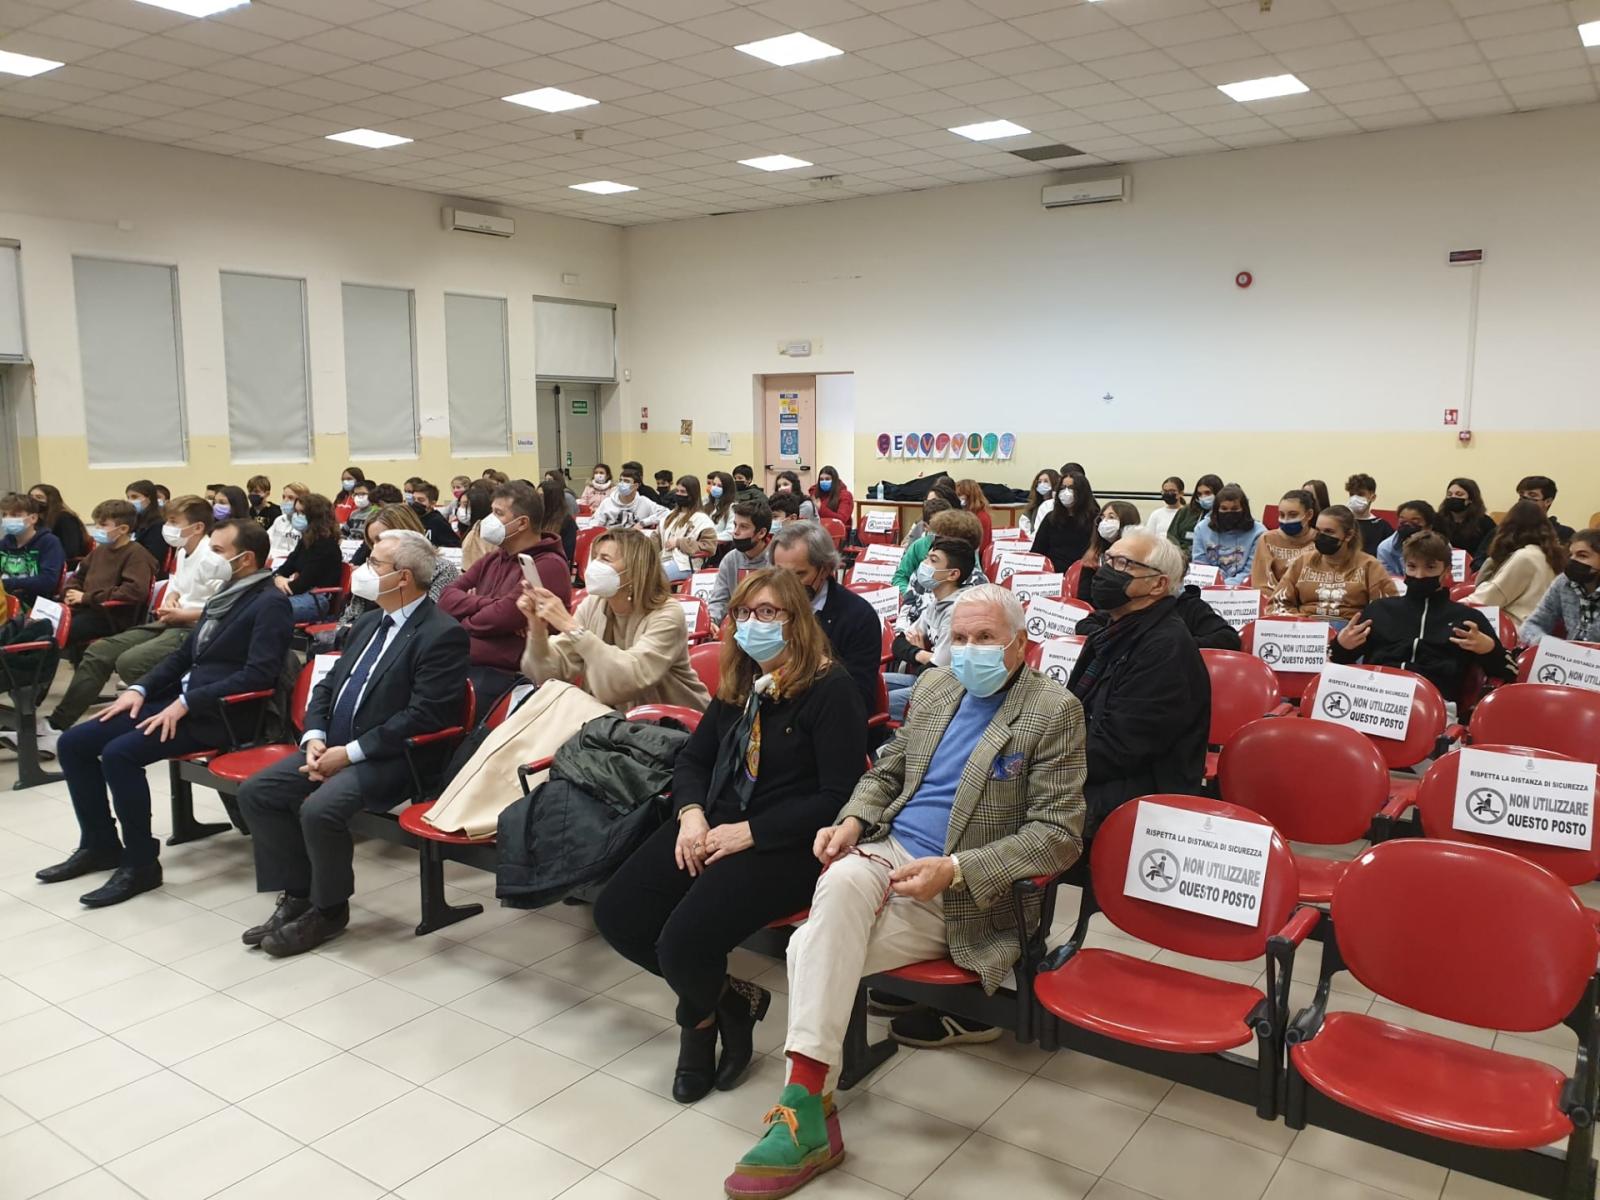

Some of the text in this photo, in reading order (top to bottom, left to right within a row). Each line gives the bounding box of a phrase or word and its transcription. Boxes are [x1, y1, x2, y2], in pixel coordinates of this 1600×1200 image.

[1057, 624, 1075, 635] UTILIZZ
[1295, 645, 1325, 653] UTILIZZARE
[1282, 656, 1304, 664] QUESTO
[1568, 670, 1583, 681] NON
[1328, 679, 1349, 687] RISPETTA
[1357, 684, 1378, 693] DISTANZA
[1385, 689, 1410, 698] SICUREZZA
[1353, 697, 1408, 716] NON UTILIZZARE
[1350, 711, 1404, 730] QUESTO POSTO
[1470, 770, 1500, 781] RISPETTA
[1511, 776, 1543, 786] DISTANZA
[1552, 781, 1589, 791] SICUREZZA
[1509, 793, 1589, 817] NON UTILIZZARE
[1507, 813, 1587, 836] QUESTO POSTO
[1146, 828, 1263, 858] RISPETTA LA DISTANZA DI SICUREZZA
[1183, 857, 1261, 888] NON UTILIZZARE
[1179, 880, 1256, 910] QUESTO POSTO
